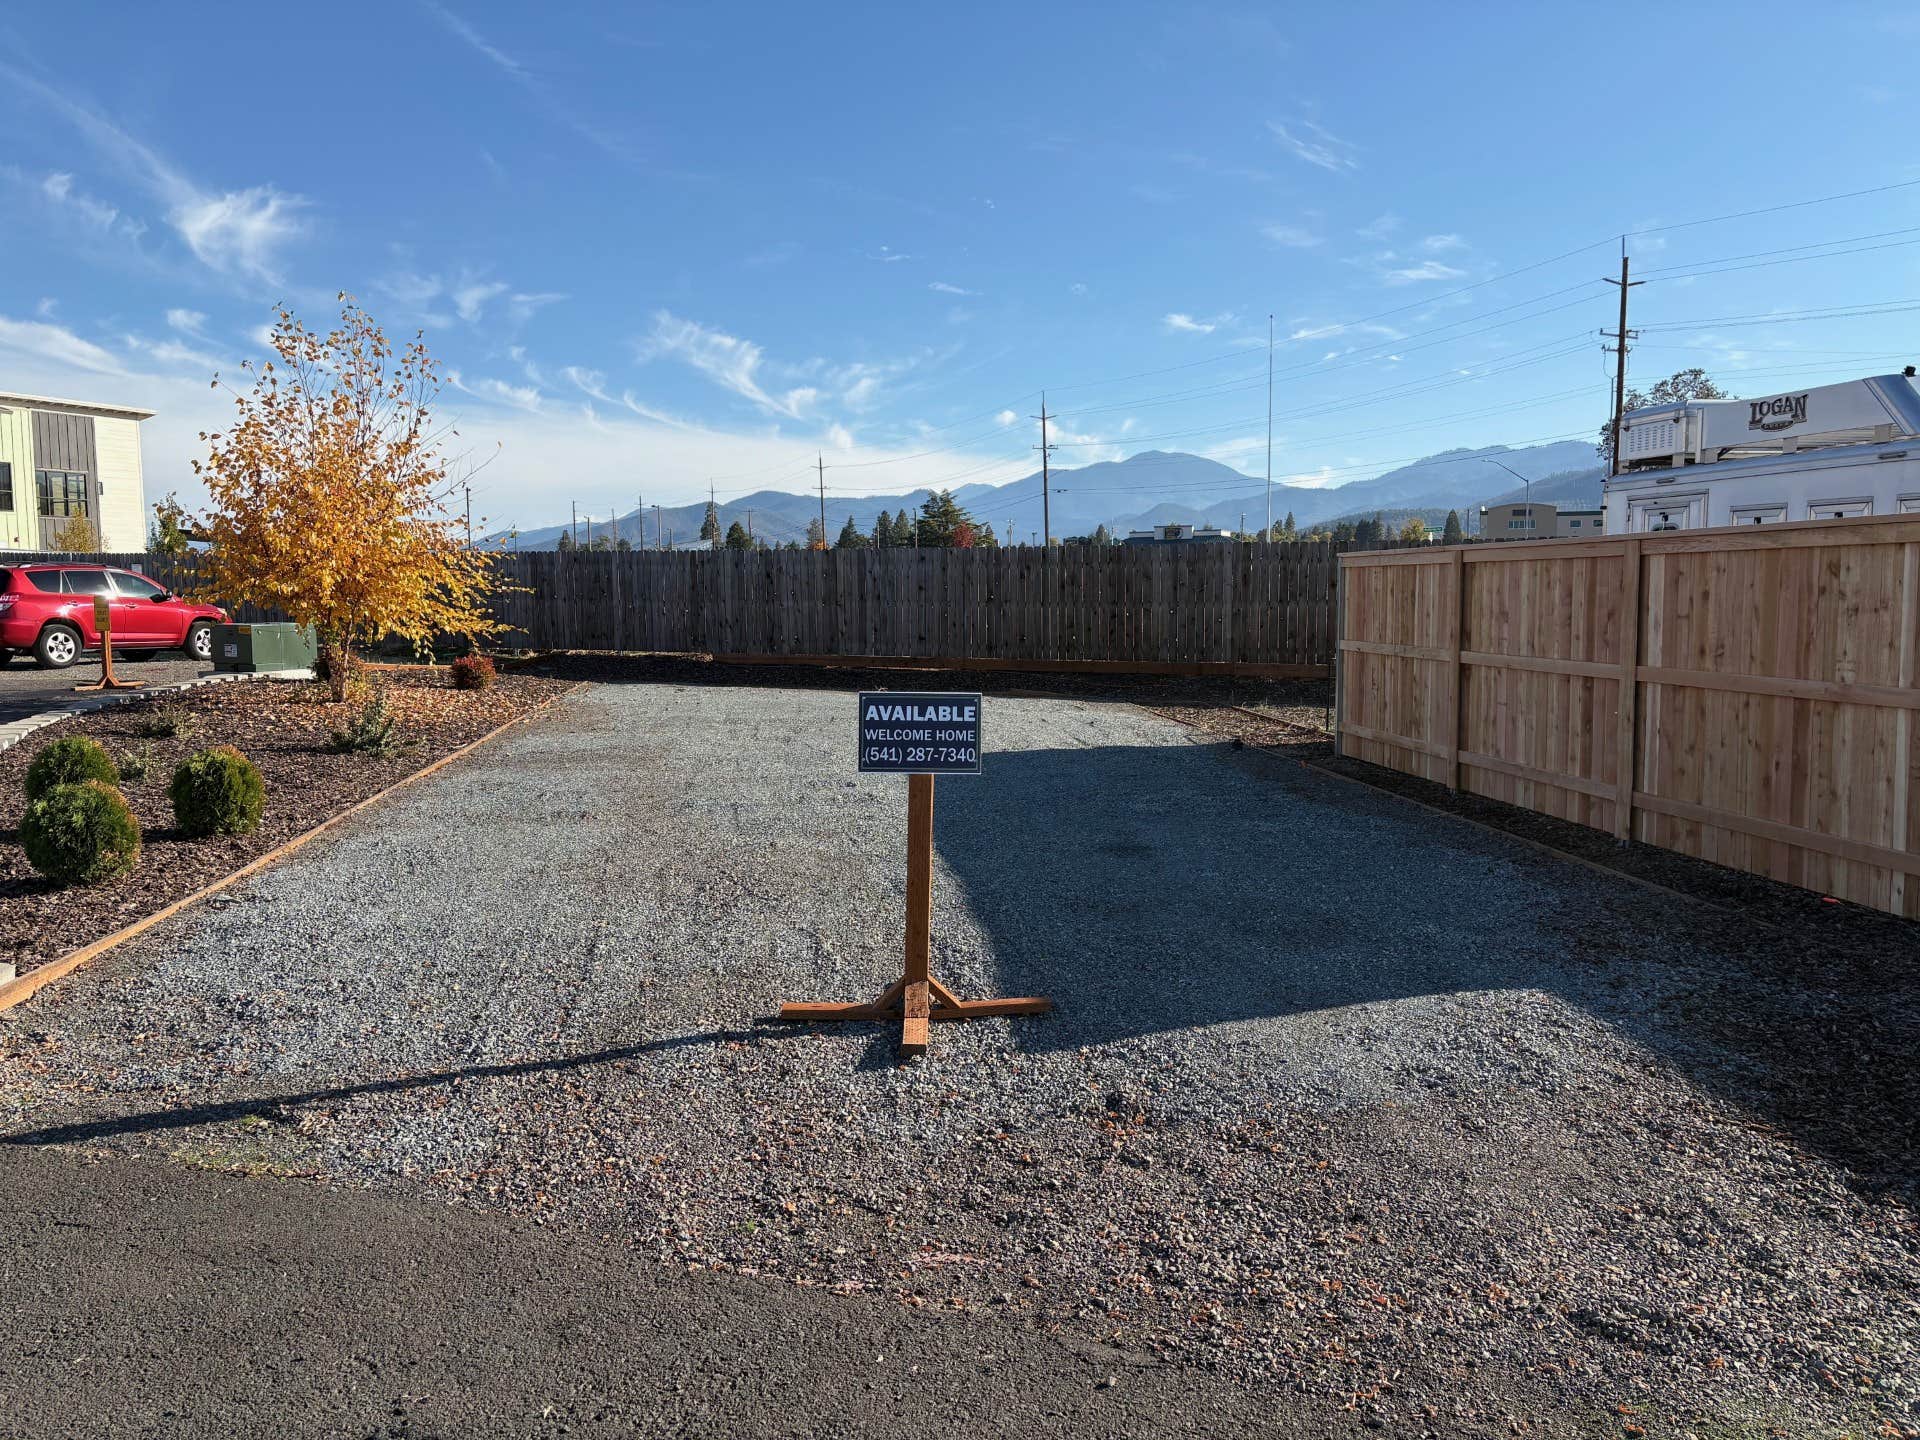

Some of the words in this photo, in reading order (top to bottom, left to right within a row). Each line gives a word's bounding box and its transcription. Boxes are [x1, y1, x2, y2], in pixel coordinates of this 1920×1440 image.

[1749, 394, 1808, 425] LOGAN
[865, 705, 976, 721] AVAILABLE
[865, 729, 932, 740] WELCOME
[936, 730, 975, 741] HOME
[865, 747, 902, 764] (541)
[907, 747, 976, 762] 287-7340
